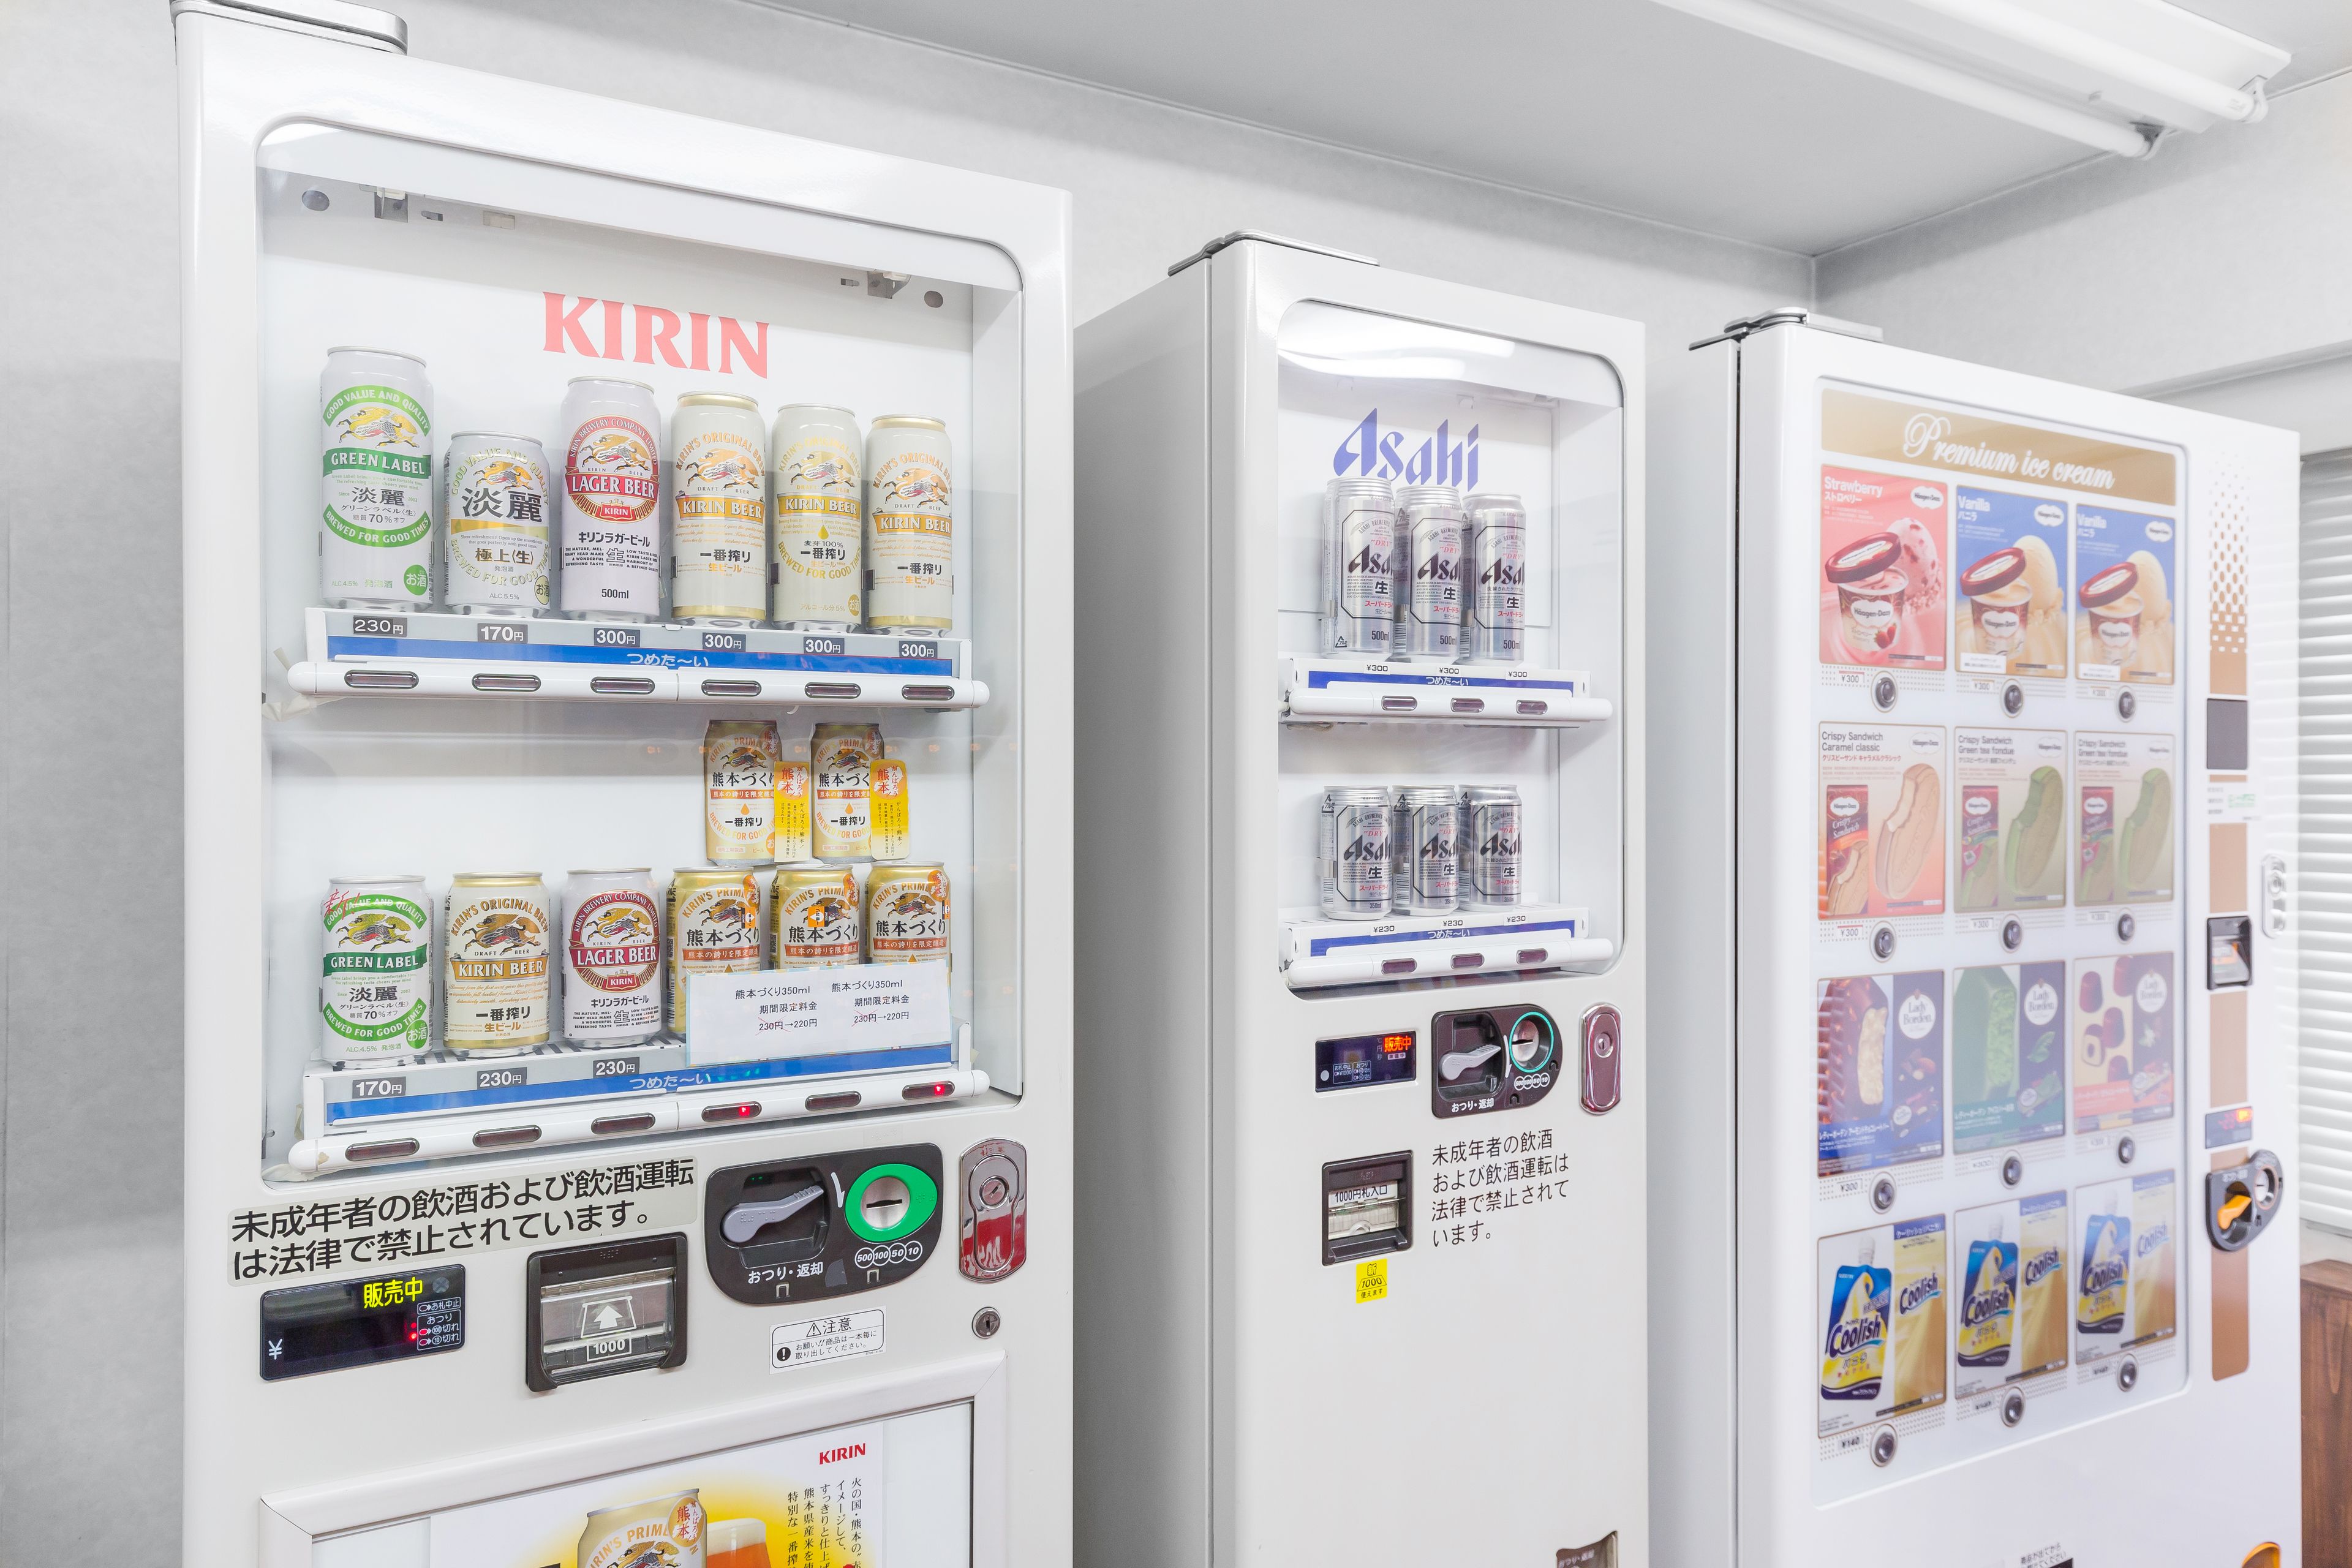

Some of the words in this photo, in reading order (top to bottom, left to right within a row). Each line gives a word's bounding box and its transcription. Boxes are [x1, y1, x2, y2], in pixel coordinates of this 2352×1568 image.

[543, 291, 769, 379] KIRIN
[326, 398, 344, 419] GOOD
[344, 390, 376, 402] VALUE
[379, 390, 399, 402] AND
[402, 399, 429, 429] QUALITY
[1333, 408, 1479, 492] Asahi
[1902, 413, 2018, 473] Premium
[2020, 450, 2051, 479] ice
[2052, 461, 2116, 489] cream
[331, 453, 379, 467] GREEN
[382, 456, 425, 474] LABEL
[572, 475, 620, 493] LAGER
[624, 478, 654, 499] BEER
[1824, 476, 1883, 497] Strawberry
[352, 487, 405, 507] 淡麗
[1958, 496, 1991, 511] Vanilla
[461, 488, 543, 522] 淡麗
[605, 507, 628, 516] KIRIN
[683, 500, 725, 514] KIRIN
[731, 502, 763, 519] BEER
[785, 498, 824, 510] KIRIN
[829, 499, 857, 514] BEER
[326, 511, 356, 538] BREWED
[358, 532, 379, 543] FOR
[382, 533, 410, 543] GOOD
[410, 518, 429, 538] TIMES
[881, 517, 920, 529] KIRIN
[925, 518, 951, 533] BEER
[2077, 513, 2108, 529] Vanilla
[578, 531, 650, 548] キリンラガービール
[606, 548, 625, 563] 生
[700, 549, 751, 563] 一番搾り
[801, 548, 845, 560] 一番搾り
[708, 562, 742, 573] 生ビール
[897, 562, 942, 575] 一番搾り
[905, 576, 935, 585] 生ビール
[1375, 581, 1388, 595] 生
[601, 589, 629, 599] 500ml
[1444, 587, 1456, 600] 生
[1507, 597, 1519, 609] 生
[355, 619, 404, 635] 230円
[481, 626, 524, 641] 170円
[597, 630, 635, 645] 300円
[704, 634, 742, 649] 300円
[1504, 640, 1520, 649] 500ml
[805, 639, 841, 653] 300円
[902, 644, 934, 657] 300円
[1842, 674, 1860, 683] ¥300
[1822, 731, 1846, 742] Crispy
[1849, 732, 1883, 741] Sandwich
[1958, 735, 1980, 745] Crispy
[1981, 735, 2013, 745] Sandwich
[1822, 743, 1853, 752] Caramel
[1855, 743, 1880, 752] classic
[1991, 746, 2015, 755] fondue
[725, 817, 763, 827] 一番搾り
[831, 816, 865, 826] 一番搾り
[1833, 816, 1852, 829] Crispy
[1833, 823, 1860, 839] Sandwich
[1368, 866, 1382, 880] 生
[1442, 864, 1455, 876] 生
[1504, 867, 1515, 877] 生
[789, 924, 858, 943] 熊本づくり
[876, 919, 946, 937] 熊本づくり
[1841, 928, 1859, 937] ¥300
[687, 927, 760, 946] 熊本づくり
[331, 956, 373, 968] GREEN
[377, 955, 419, 968] LABEL
[577, 949, 625, 965] LAGER
[628, 946, 657, 963] BEER
[459, 963, 504, 977] KIRIN
[510, 960, 543, 976] BEER
[349, 986, 398, 1003] 淡麗
[591, 995, 649, 1008] キリンラガービール
[854, 995, 910, 1007] 期間限定料金
[2032, 990, 2051, 1003] Lady
[760, 1001, 818, 1014] 期間限定料金
[1908, 1001, 1928, 1016] Lady
[2027, 1000, 2055, 1012] Borden
[325, 1008, 352, 1034] BREWED
[377, 1023, 403, 1036] GOOD
[403, 1003, 423, 1026] TIMES
[476, 1006, 530, 1022] 一番搾り
[614, 1010, 630, 1023] 生
[1902, 1012, 1932, 1025] Borden
[484, 1022, 521, 1032] 生ビール
[1384, 1036, 1411, 1052] 販売中
[596, 1062, 636, 1077] 230円
[480, 1071, 522, 1087] 230円
[356, 1080, 402, 1096] 170円
[1452, 1099, 1494, 1113] おつり・返却
[1432, 1129, 1553, 1166] 未成年者の飲酒
[1433, 1154, 1569, 1193] および飲酒運転は
[232, 1158, 695, 1243] 未成年者の飲酒および飲酒運転
[1335, 1185, 1387, 1203] 1000円札入口
[1432, 1180, 1569, 1221] 法律で禁止されて
[234, 1200, 648, 1280] は法律で禁止されています。
[1433, 1221, 1491, 1248] います。
[857, 1253, 873, 1263] 500
[875, 1250, 889, 1259] 100
[891, 1248, 904, 1257] 50
[907, 1245, 919, 1255] 10
[1367, 1263, 1377, 1276] 新
[2025, 1244, 2060, 1286] Coolish
[747, 1262, 823, 1285] おつり・返却
[2083, 1259, 2124, 1297] Coolish
[1362, 1278, 1382, 1288] 1000
[364, 1277, 423, 1309] 販売中
[1361, 1289, 1383, 1298] 使えます
[1900, 1272, 1939, 1315] Coolish
[432, 1299, 459, 1311] お札中止
[1964, 1284, 2011, 1328] Coolish
[427, 1313, 453, 1325] おつり
[823, 1317, 851, 1334] 注意
[1828, 1314, 1881, 1360] Coolish
[593, 1339, 625, 1354] 1000
[819, 1442, 865, 1465] KIRIN
